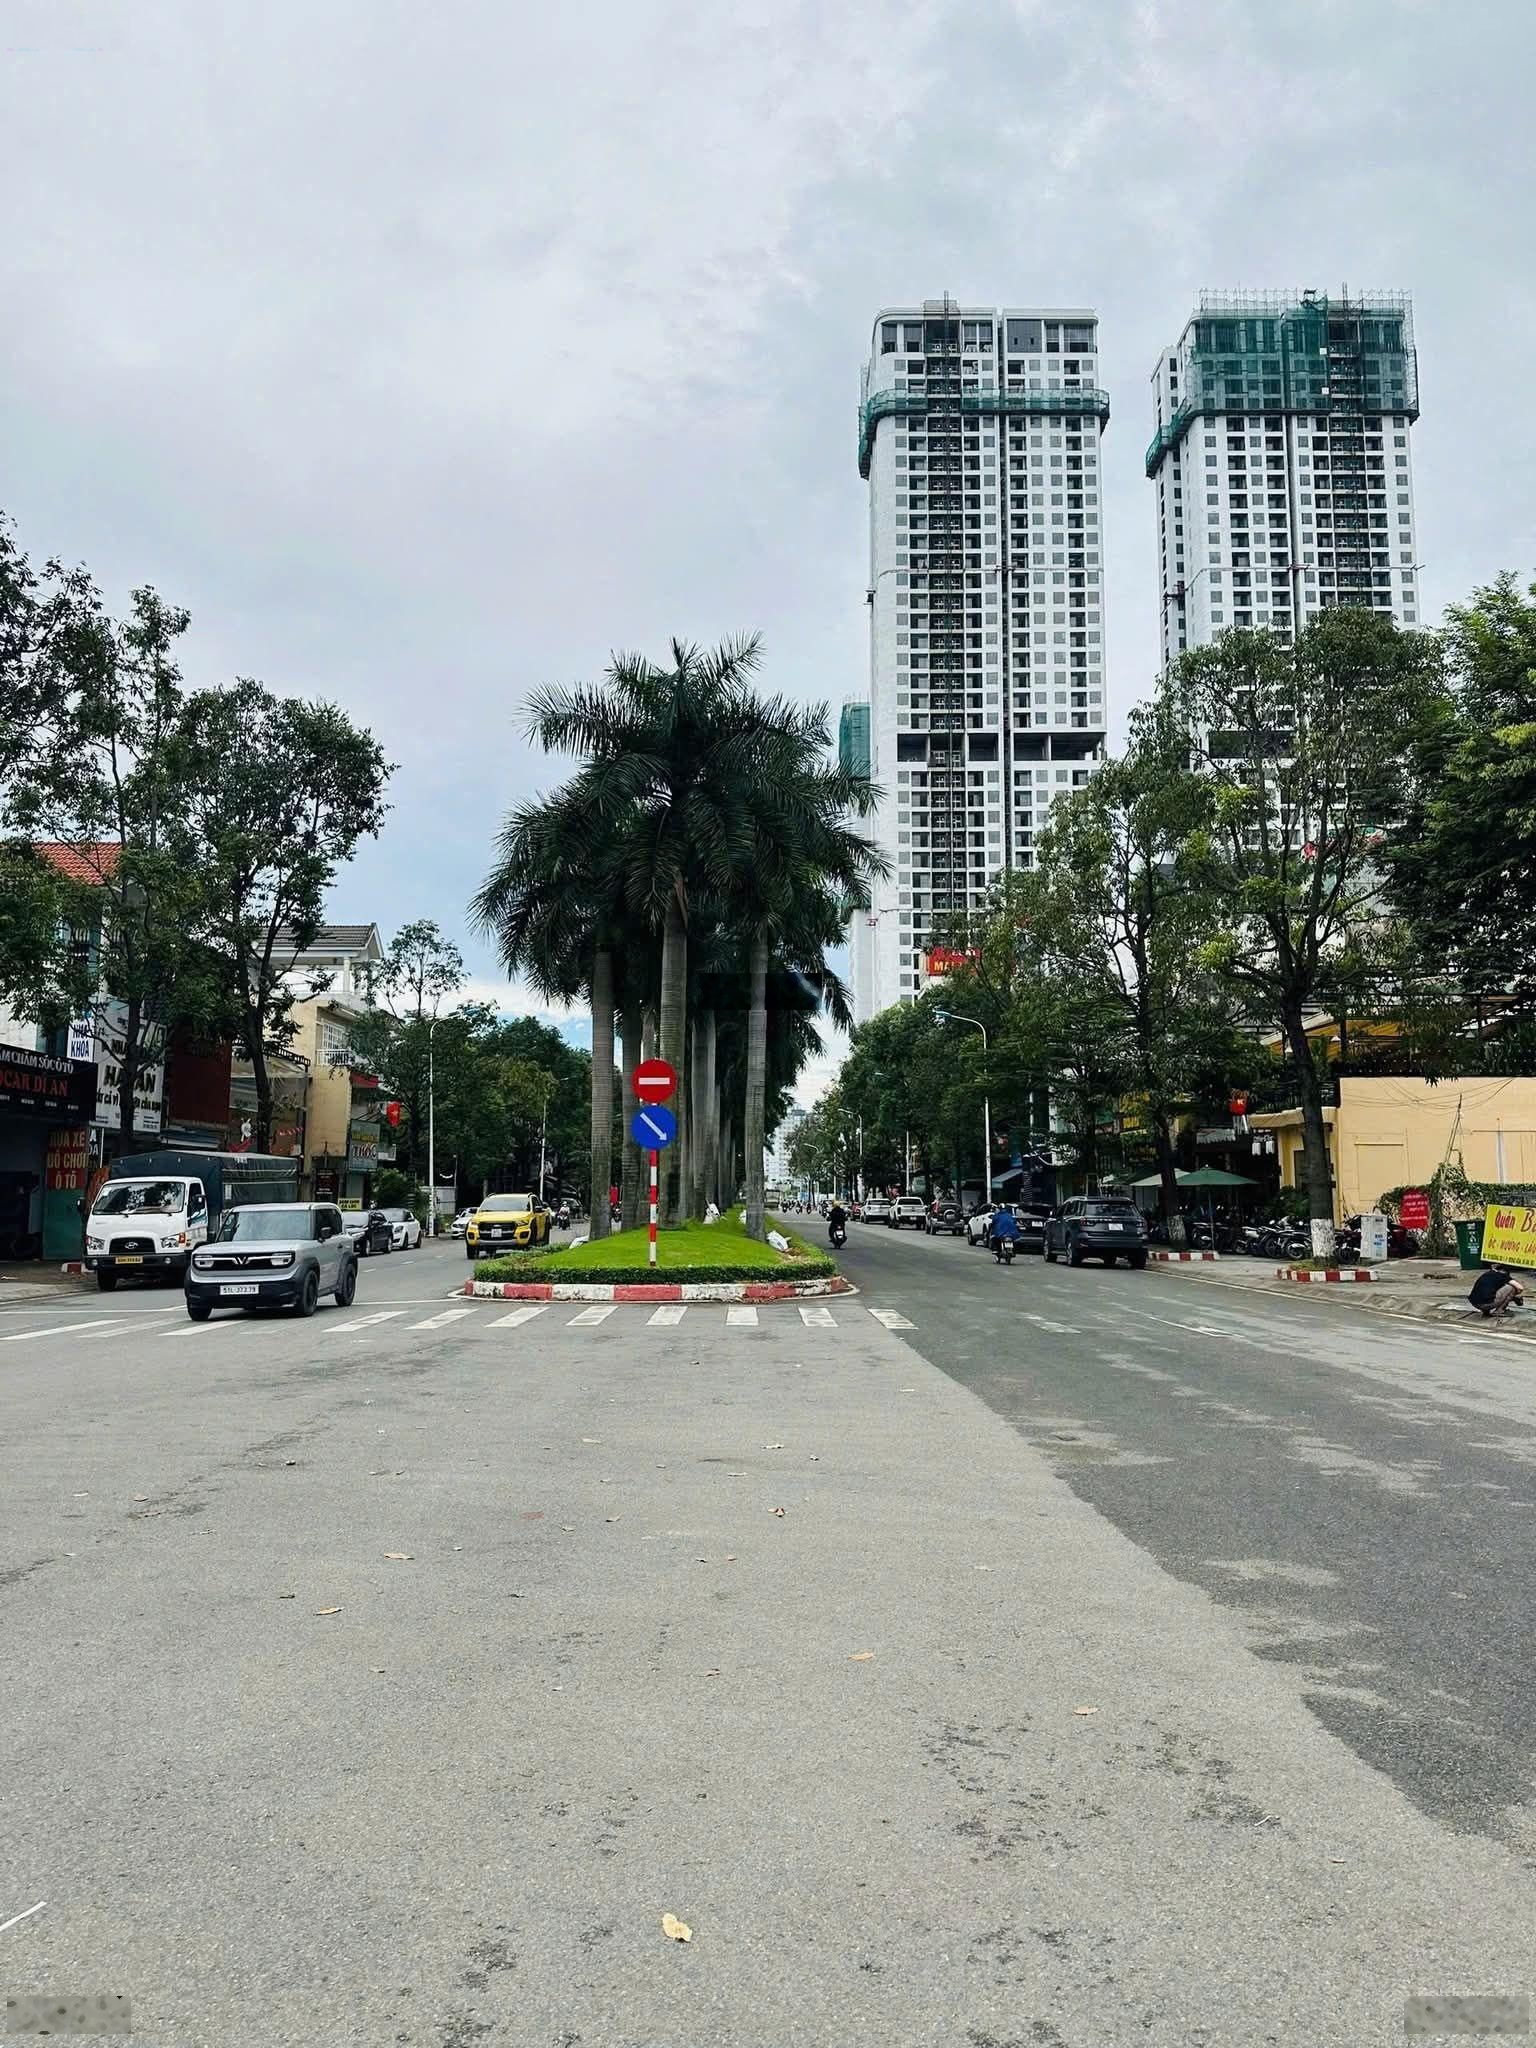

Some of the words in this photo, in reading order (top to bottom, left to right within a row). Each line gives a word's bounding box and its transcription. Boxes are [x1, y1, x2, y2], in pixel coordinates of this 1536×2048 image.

[71, 1040, 89, 1058] KHOA
[11, 1051, 37, 1068] CHĂM
[38, 1054, 55, 1070] SÓC
[62, 1060, 74, 1074] TÔ
[50, 1079, 68, 1097] AN
[64, 1171, 76, 1189] TÔ
[1494, 1210, 1516, 1230] Quán
